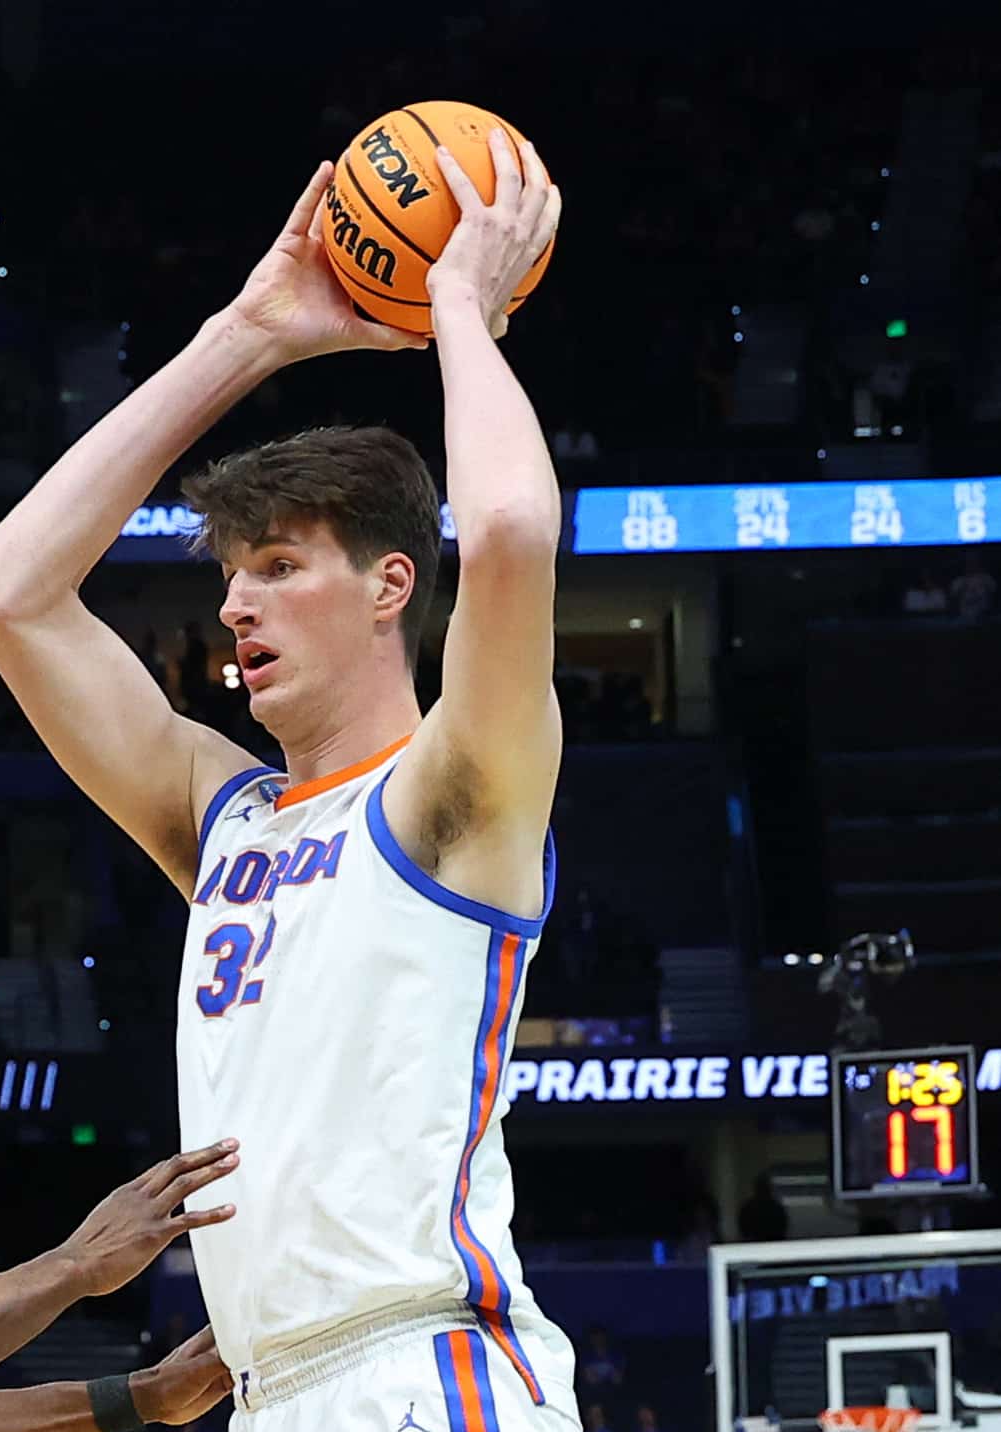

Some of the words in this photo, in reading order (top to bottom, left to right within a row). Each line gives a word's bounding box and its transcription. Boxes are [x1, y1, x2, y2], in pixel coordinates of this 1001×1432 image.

[361, 125, 431, 209] NCAA
[325, 182, 399, 287] Wilso
[622, 515, 678, 550] 88
[736, 512, 790, 546] 24
[850, 509, 904, 544] 24
[958, 509, 986, 542] 6
[505, 1057, 730, 1102] PRAIRIE
[741, 1055, 829, 1097] VIE
[887, 1061, 963, 1105] 1:25
[888, 1106, 955, 1178] 17
